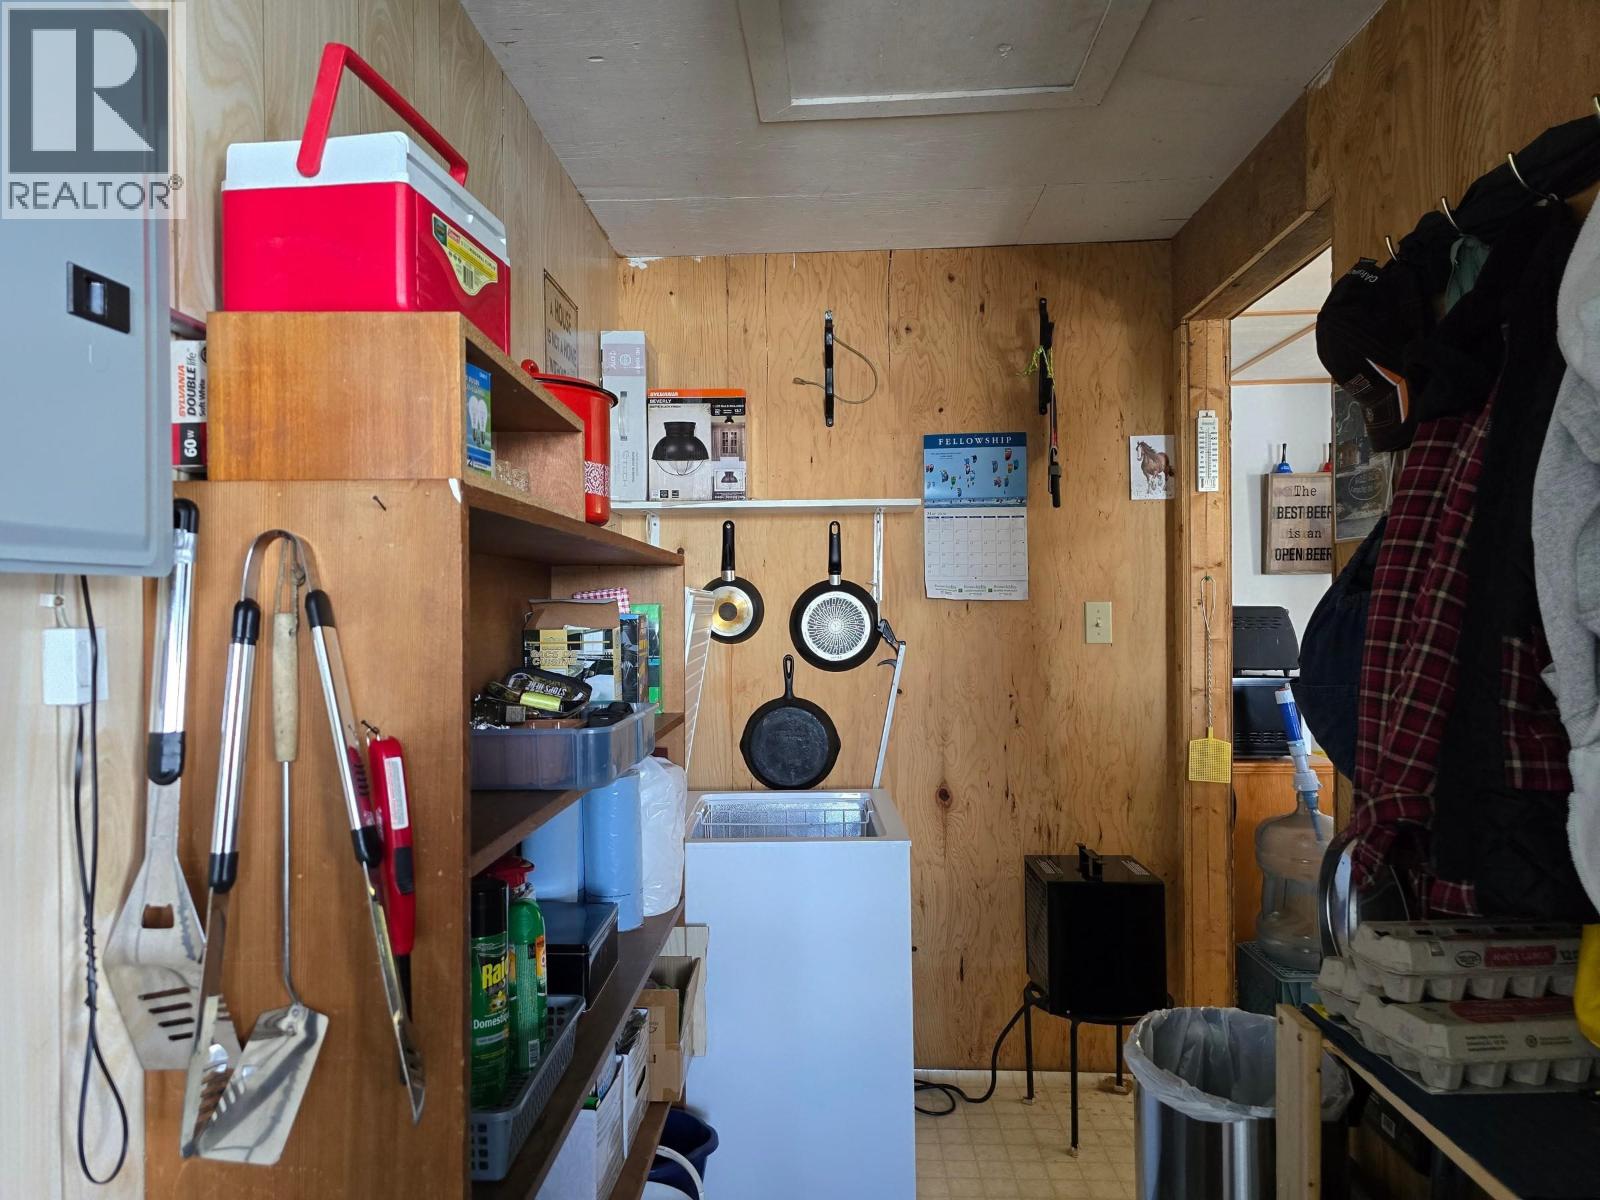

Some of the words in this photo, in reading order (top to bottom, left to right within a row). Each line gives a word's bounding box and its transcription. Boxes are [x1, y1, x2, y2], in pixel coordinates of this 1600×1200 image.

[177, 363, 186, 417] SYLVANIA
[186, 366, 196, 416] DOUBLE
[938, 436, 1012, 446] FELLOWSHIP
[1294, 486, 1317, 497] The
[1277, 505, 1304, 519] BEST
[1288, 528, 1301, 539] is
[1307, 530, 1322, 539] an
[1275, 547, 1303, 561] OPEN
